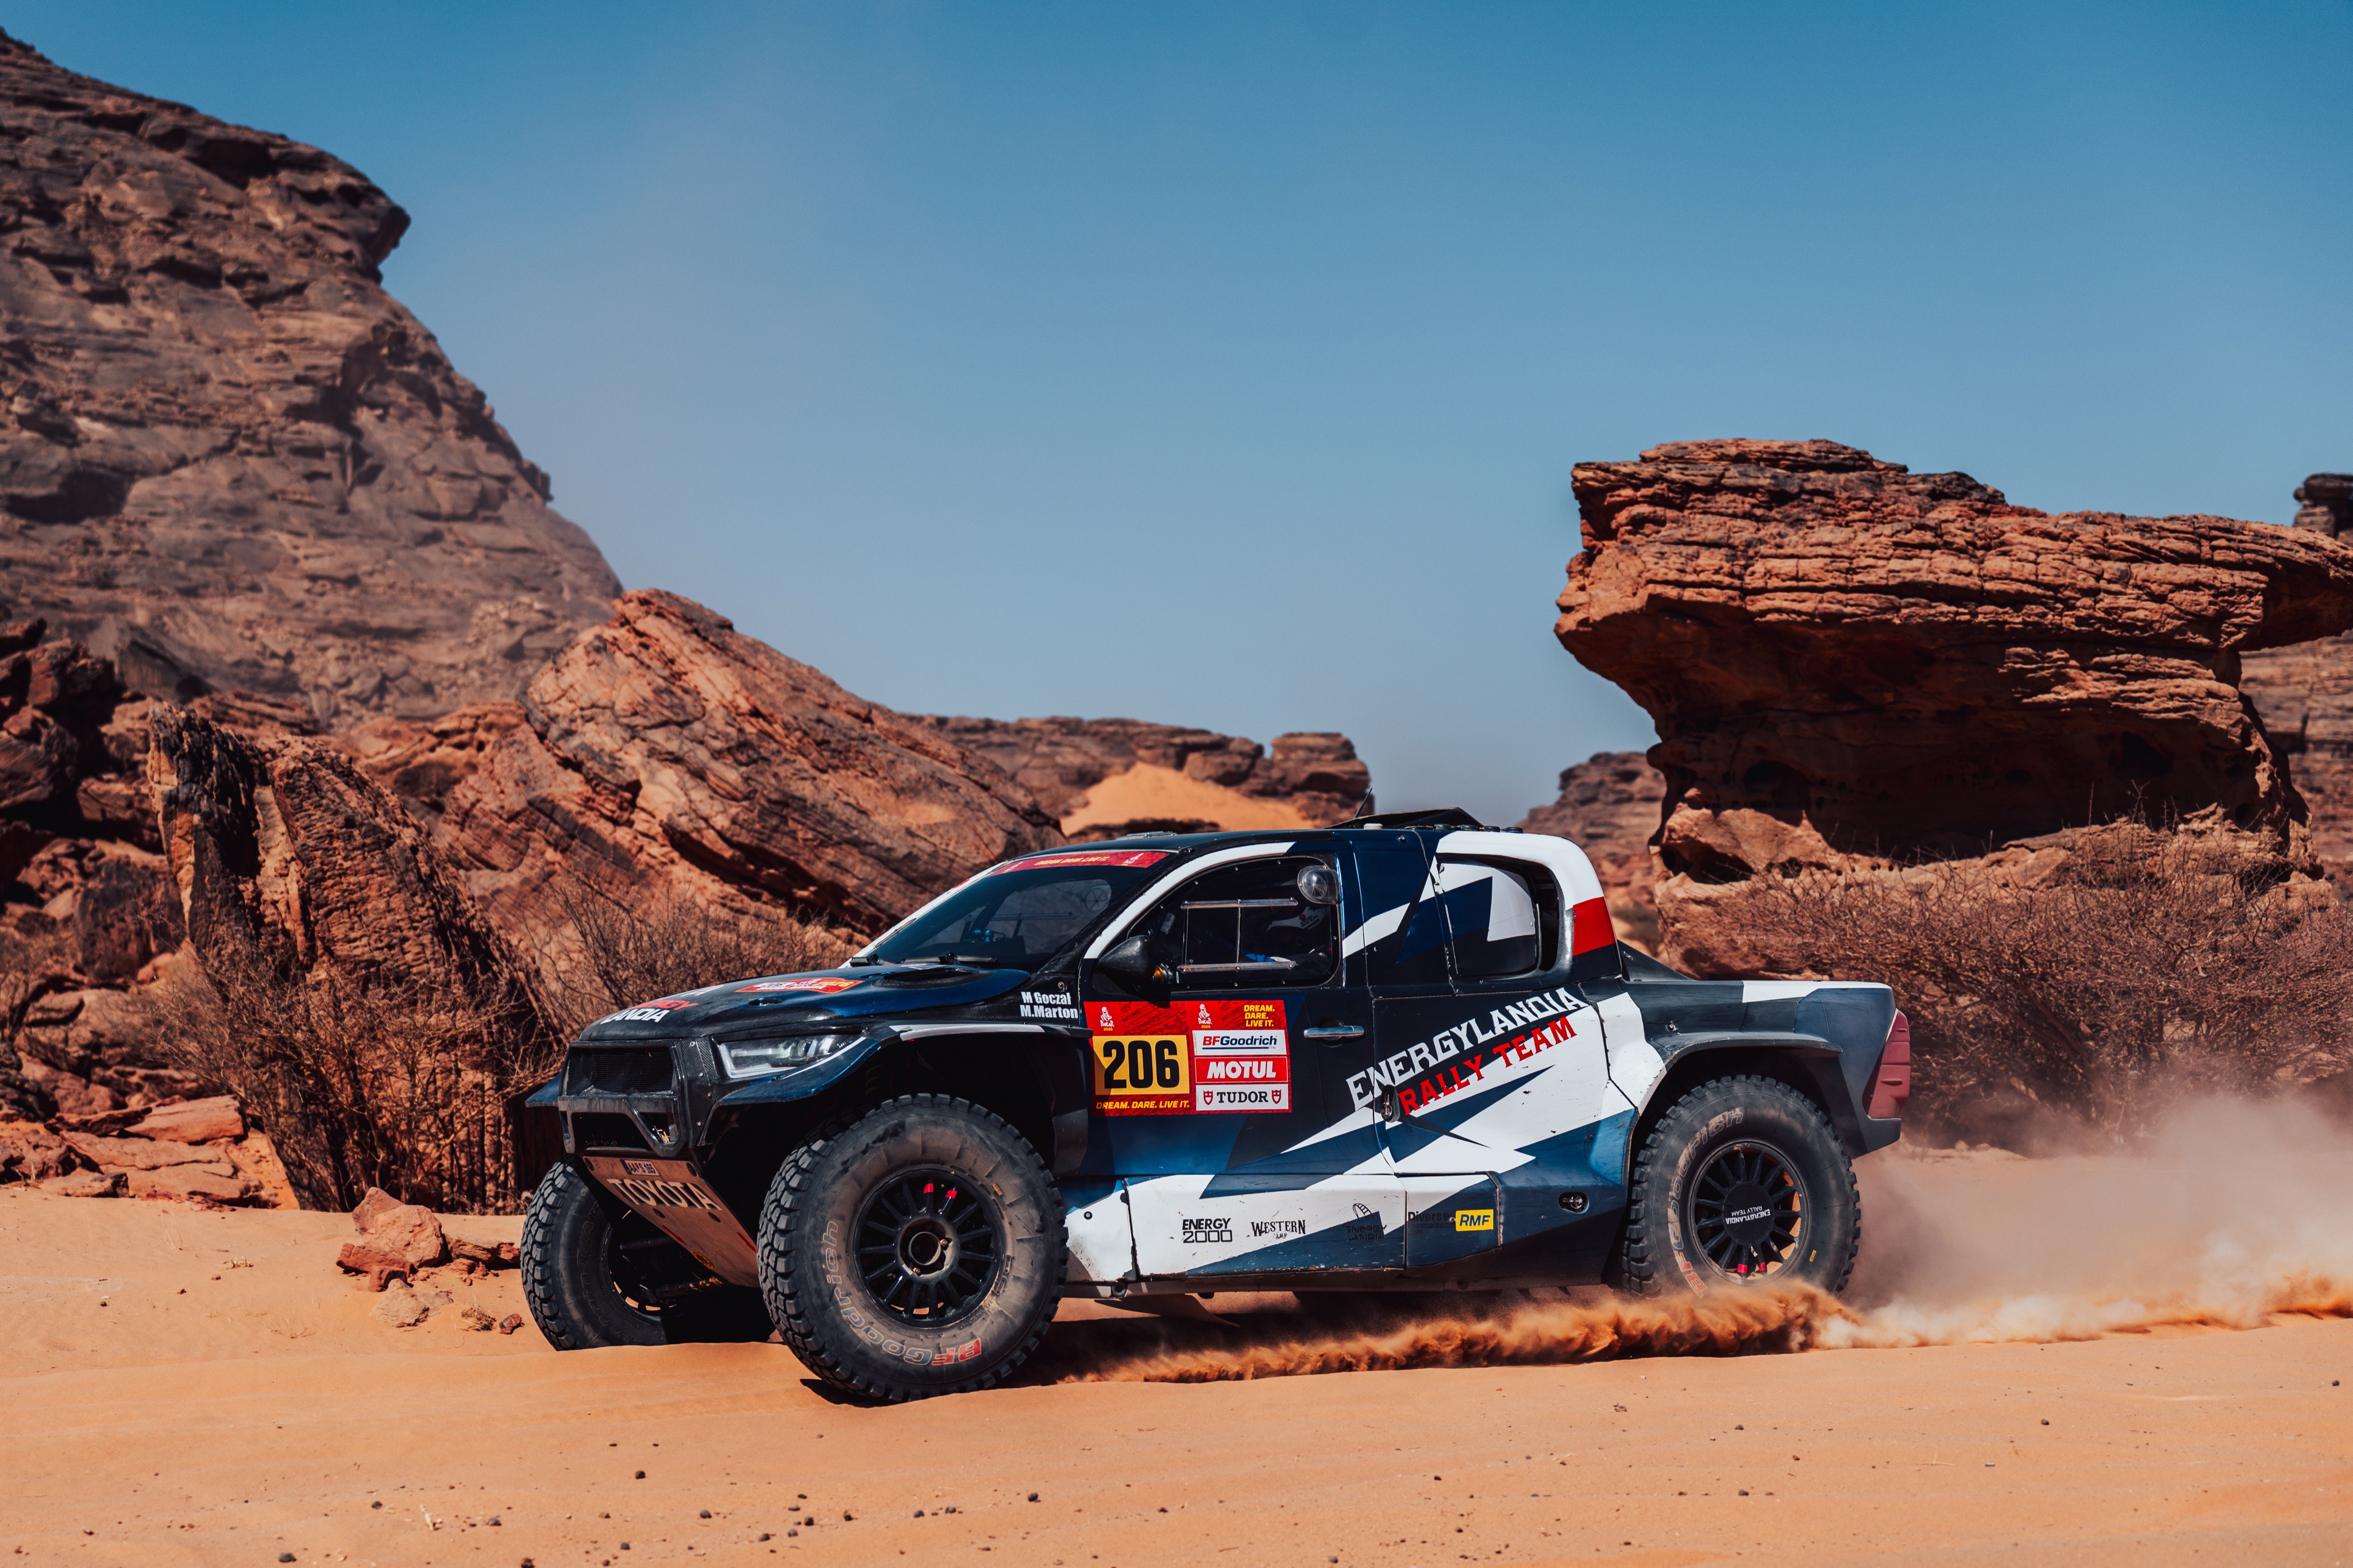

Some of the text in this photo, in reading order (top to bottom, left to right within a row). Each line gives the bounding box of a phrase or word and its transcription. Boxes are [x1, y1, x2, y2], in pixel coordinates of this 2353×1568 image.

[1021, 991, 1071, 1005] M Goczał
[1020, 1005, 1078, 1018] M.Marton
[1100, 1019, 1114, 1028] DAKAR
[1202, 1036, 1277, 1046] BFGoodrich
[1346, 987, 1590, 1112] ENERGYLANDIA
[1103, 1040, 1180, 1089] 206
[1207, 1061, 1276, 1079] MOTUL
[1397, 1016, 1577, 1116] RALLY TEAM
[1217, 1091, 1268, 1103] TUDOR
[1096, 1102, 1129, 1110] DREAM.
[1131, 1101, 1157, 1109] DARE.
[1159, 1100, 1178, 1109] LIVE
[606, 1179, 723, 1211] TOYOTA
[1408, 1211, 1450, 1222] Diverse
[1725, 1208, 1770, 1225] ENERGYLANDIA
[1731, 1206, 1762, 1216] RALLY TEAM
[1182, 1218, 1231, 1230] ENERGY
[1460, 1214, 1491, 1226] RMF
[1251, 1220, 1306, 1237] WESTERN
[1183, 1230, 1233, 1243] 2000
[823, 1221, 982, 1366] BFGoodrich
